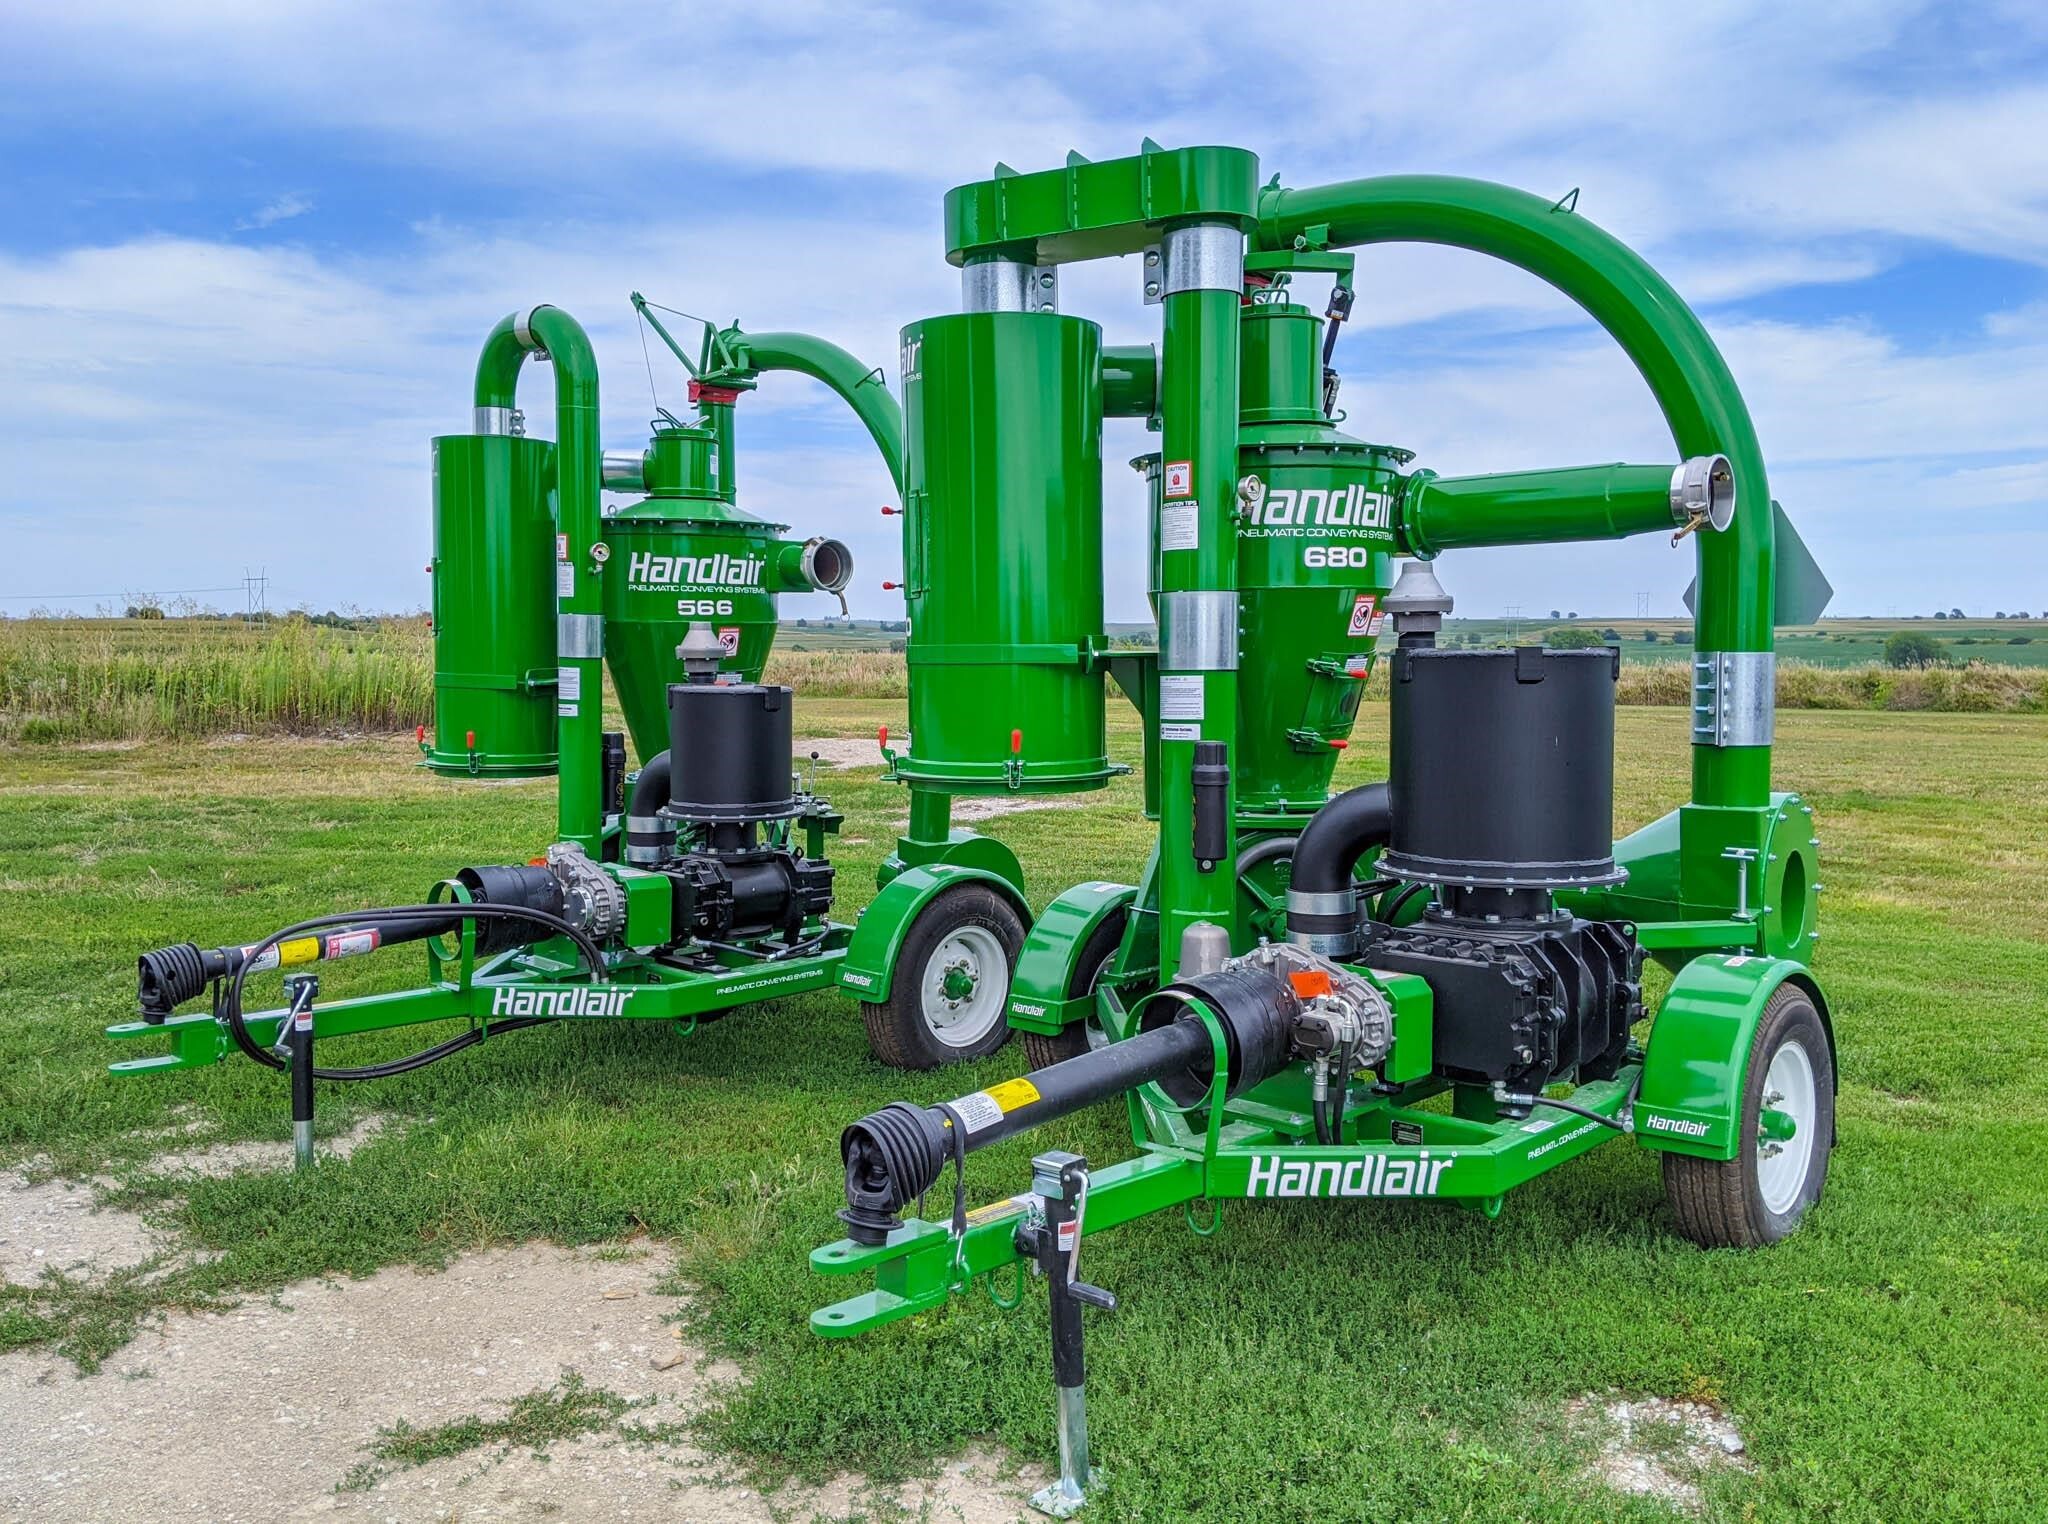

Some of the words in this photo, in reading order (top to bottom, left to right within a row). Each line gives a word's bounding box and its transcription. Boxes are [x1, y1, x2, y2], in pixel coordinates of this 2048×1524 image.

[1167, 465, 1188, 473] CAUTION
[1238, 528, 1304, 538] NEUMATIC
[1306, 528, 1368, 538] CONVEYING
[1368, 530, 1394, 541] SYSTEMS
[628, 551, 765, 585] Handlair
[1304, 546, 1367, 568] 680
[628, 584, 680, 592] PNEUMATIC
[680, 585, 733, 593] CONVEYING
[734, 586, 766, 594] SYSTEMS
[677, 600, 733, 616] 566
[716, 982, 756, 996] PNEUMATIC
[756, 974, 793, 989] CONVEYING
[793, 969, 824, 981] SYSTEMS
[843, 971, 873, 987] Handlair
[491, 986, 635, 1016] Handlair
[1012, 1001, 1047, 1017] Handlair
[1559, 1123, 1590, 1145] CONVEYING
[1646, 1114, 1711, 1137] Handlair
[1246, 1151, 1454, 1197] Handlair
